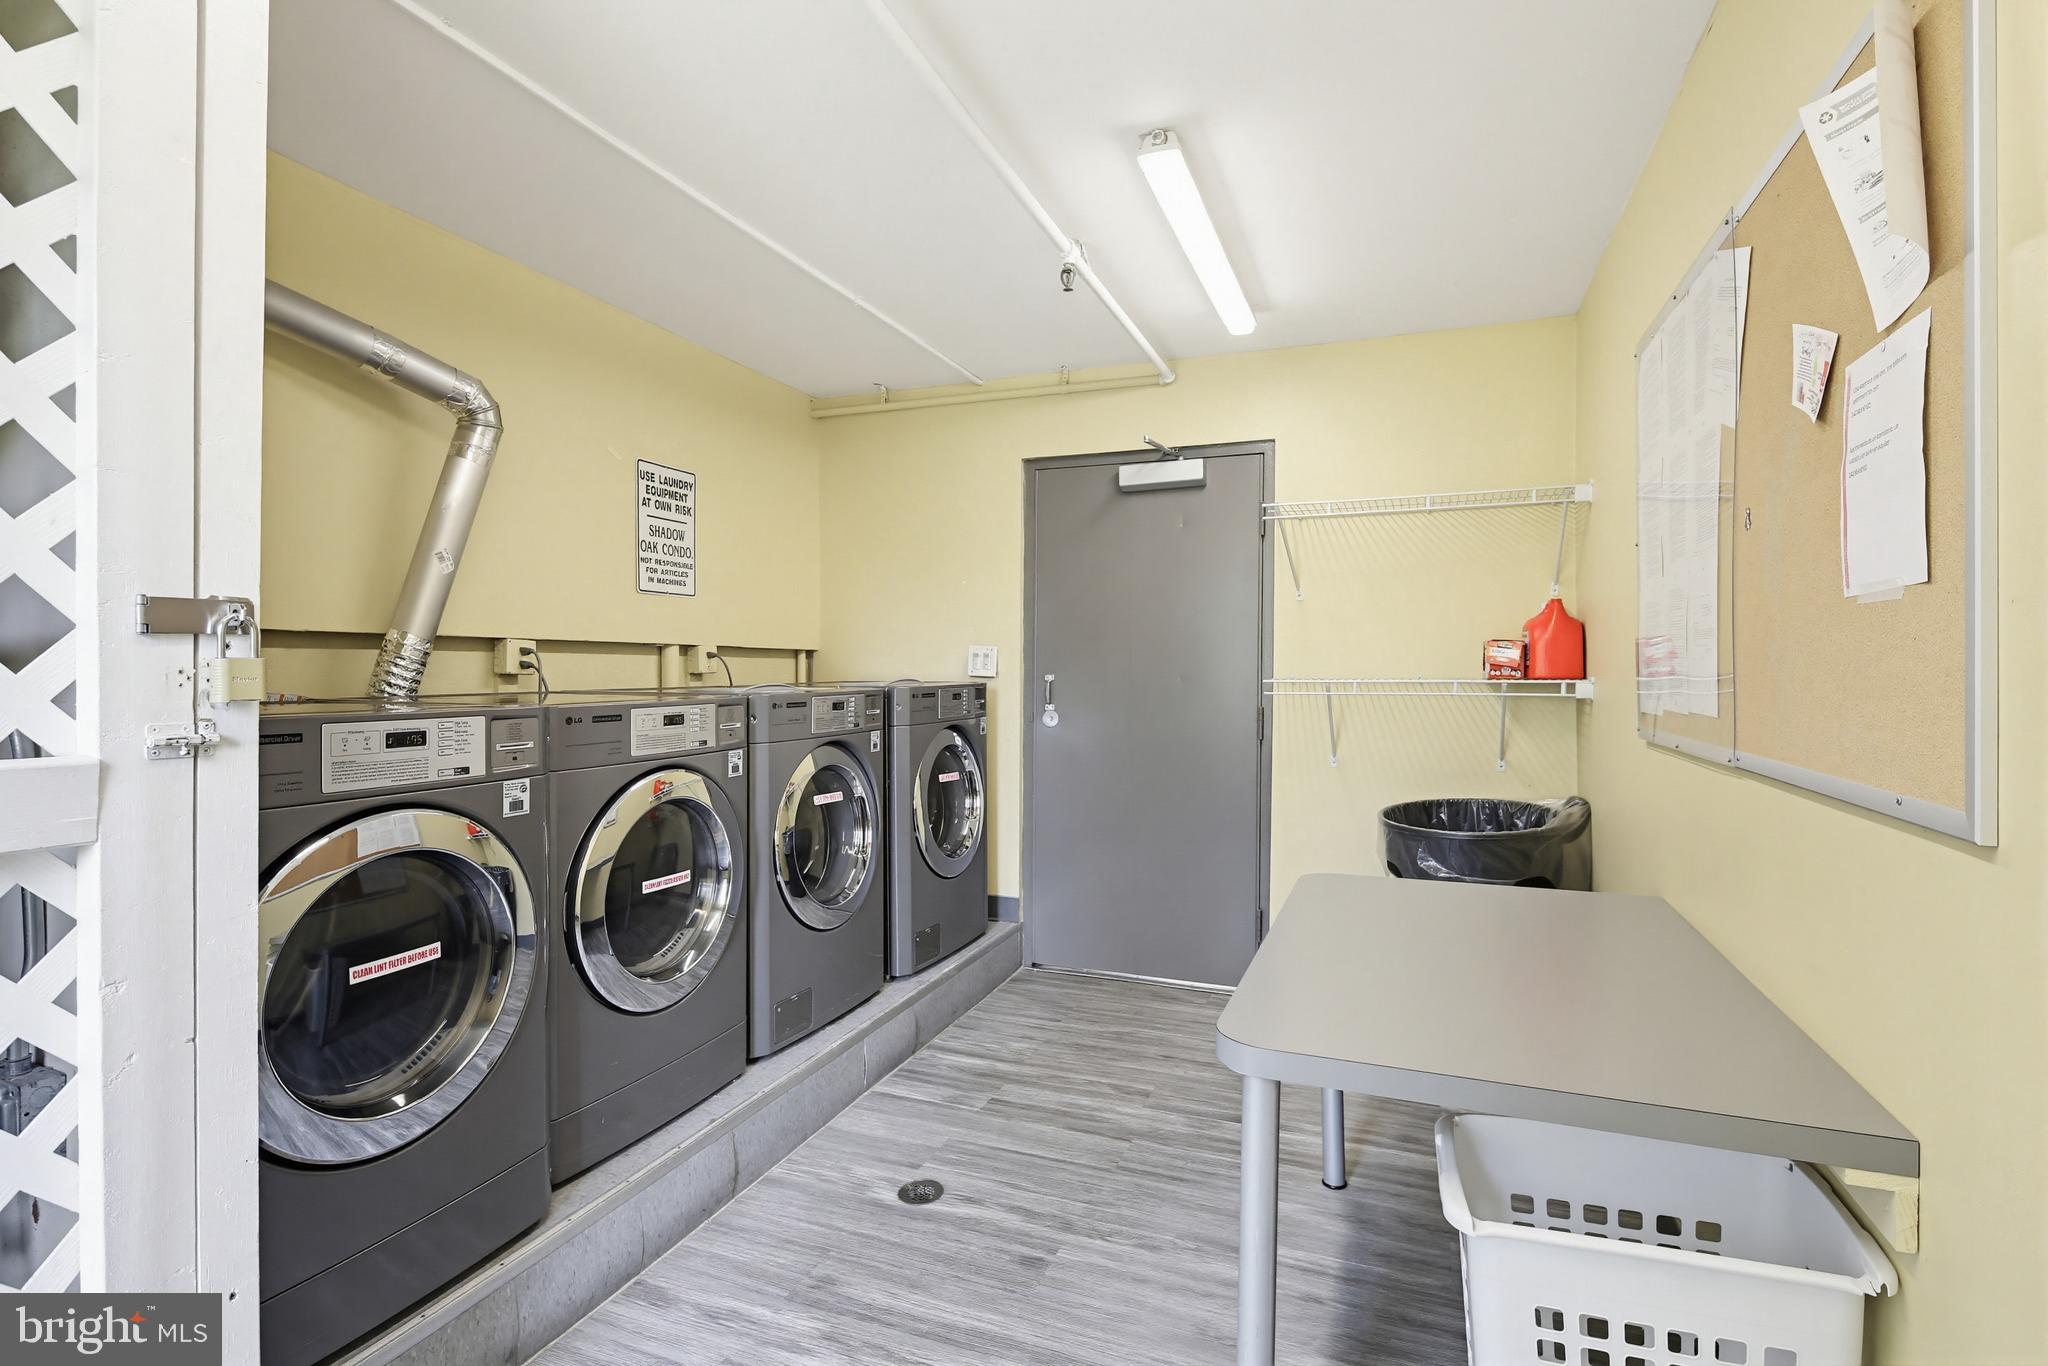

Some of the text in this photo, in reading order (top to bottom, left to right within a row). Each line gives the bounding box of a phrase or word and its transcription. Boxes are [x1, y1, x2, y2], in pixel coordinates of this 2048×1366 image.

[640, 469, 694, 492] USE LAUNDRY
[645, 484, 688, 503] EQUIPMENT
[641, 496, 692, 517] AT OWN RISK
[648, 524, 686, 542] SHADOW
[640, 539, 694, 560] OAK CONDO.
[640, 556, 694, 570] NOT RESPONSIBLE
[645, 566, 689, 578] FOR ARTICLES
[656, 577, 687, 587] MACHINES
[352, 946, 439, 980] CLEAN LINT FILTER BEFORE USE
